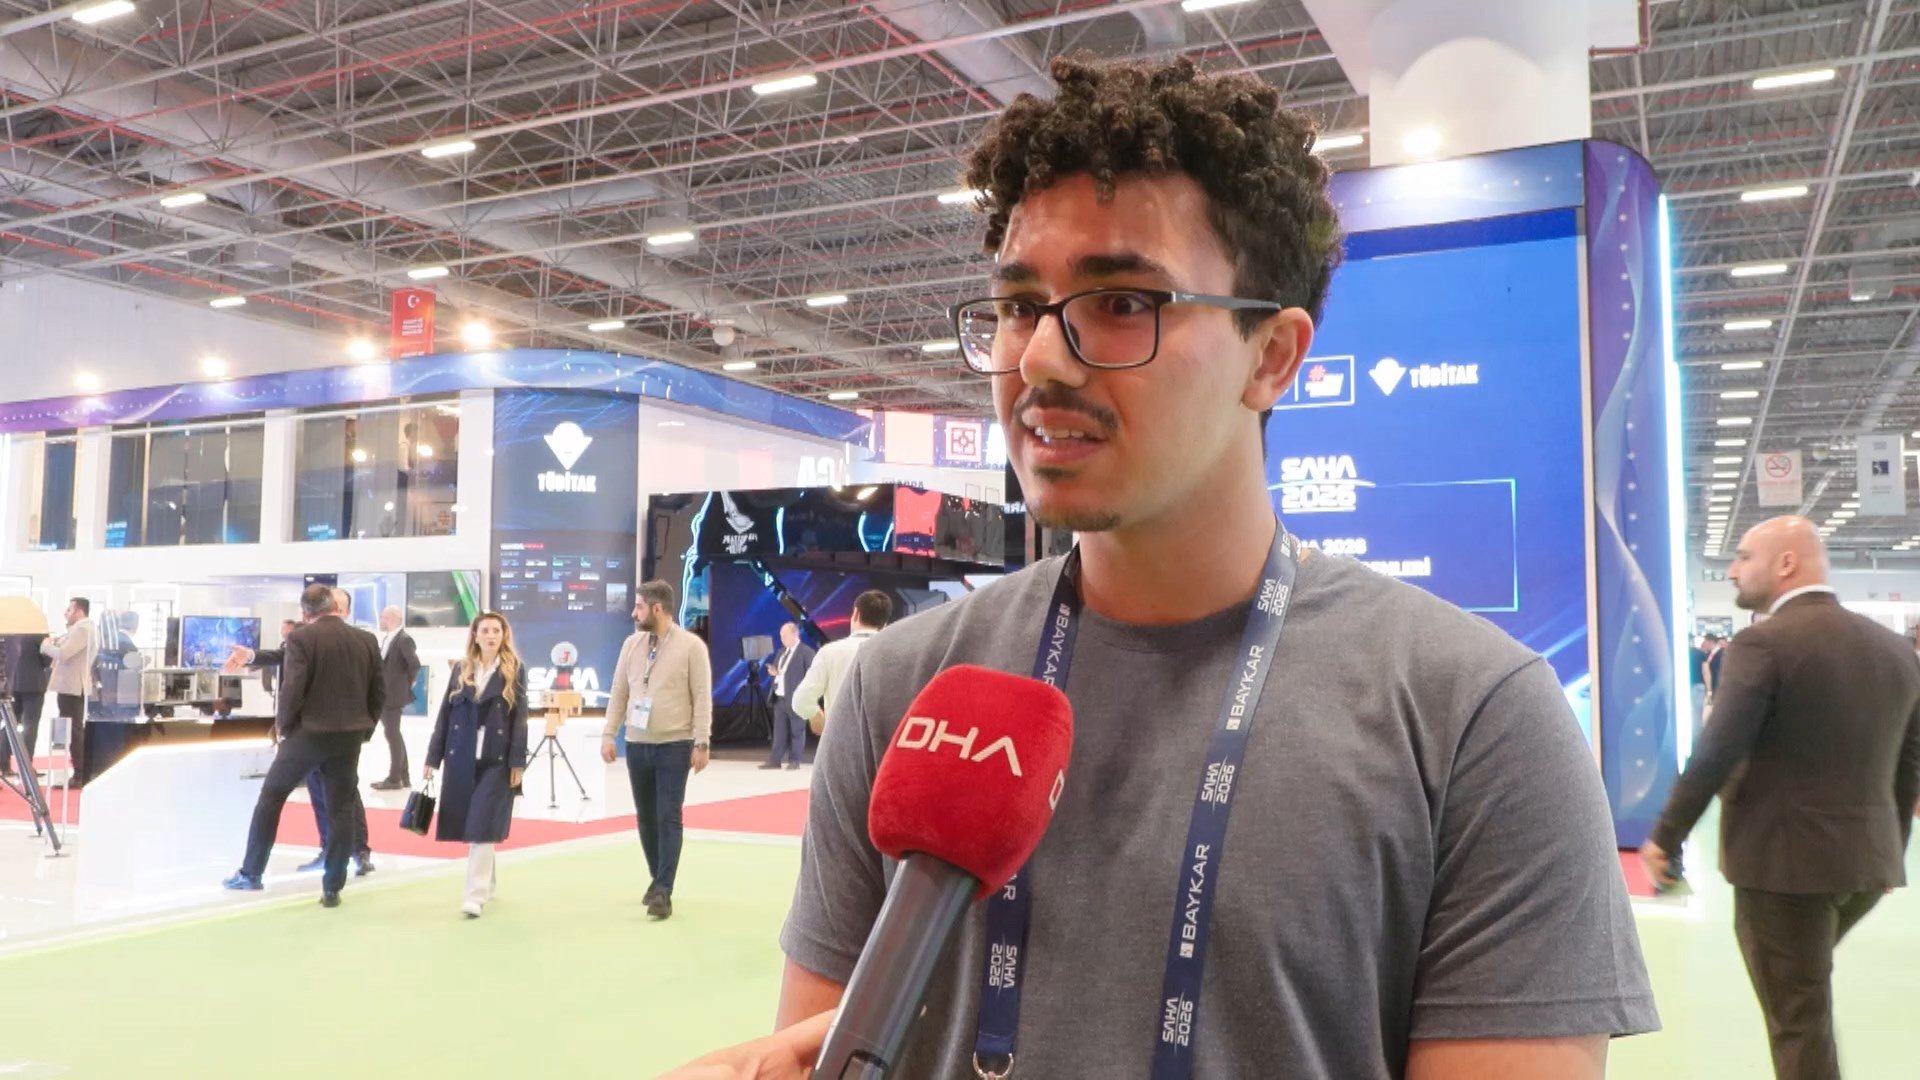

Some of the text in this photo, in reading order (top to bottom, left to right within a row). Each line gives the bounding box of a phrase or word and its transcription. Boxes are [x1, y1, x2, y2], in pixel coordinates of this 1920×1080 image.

[1409, 362, 1479, 388] TÜBİTAK
[537, 470, 597, 493] TÜBİTAK
[1281, 455, 1357, 481] SAHA
[1281, 485, 1357, 507] 2026
[1230, 645, 1264, 717] BAYKAR
[896, 717, 1023, 777] DHA
[1201, 762, 1221, 802] SAHA
[1216, 764, 1236, 804] 2026
[1182, 844, 1210, 940] BAYKAR
[988, 943, 1003, 987] 2026
[1002, 945, 1018, 989] SAHA
[1162, 997, 1179, 1044] SAHA
[1177, 1000, 1194, 1047] 2026
